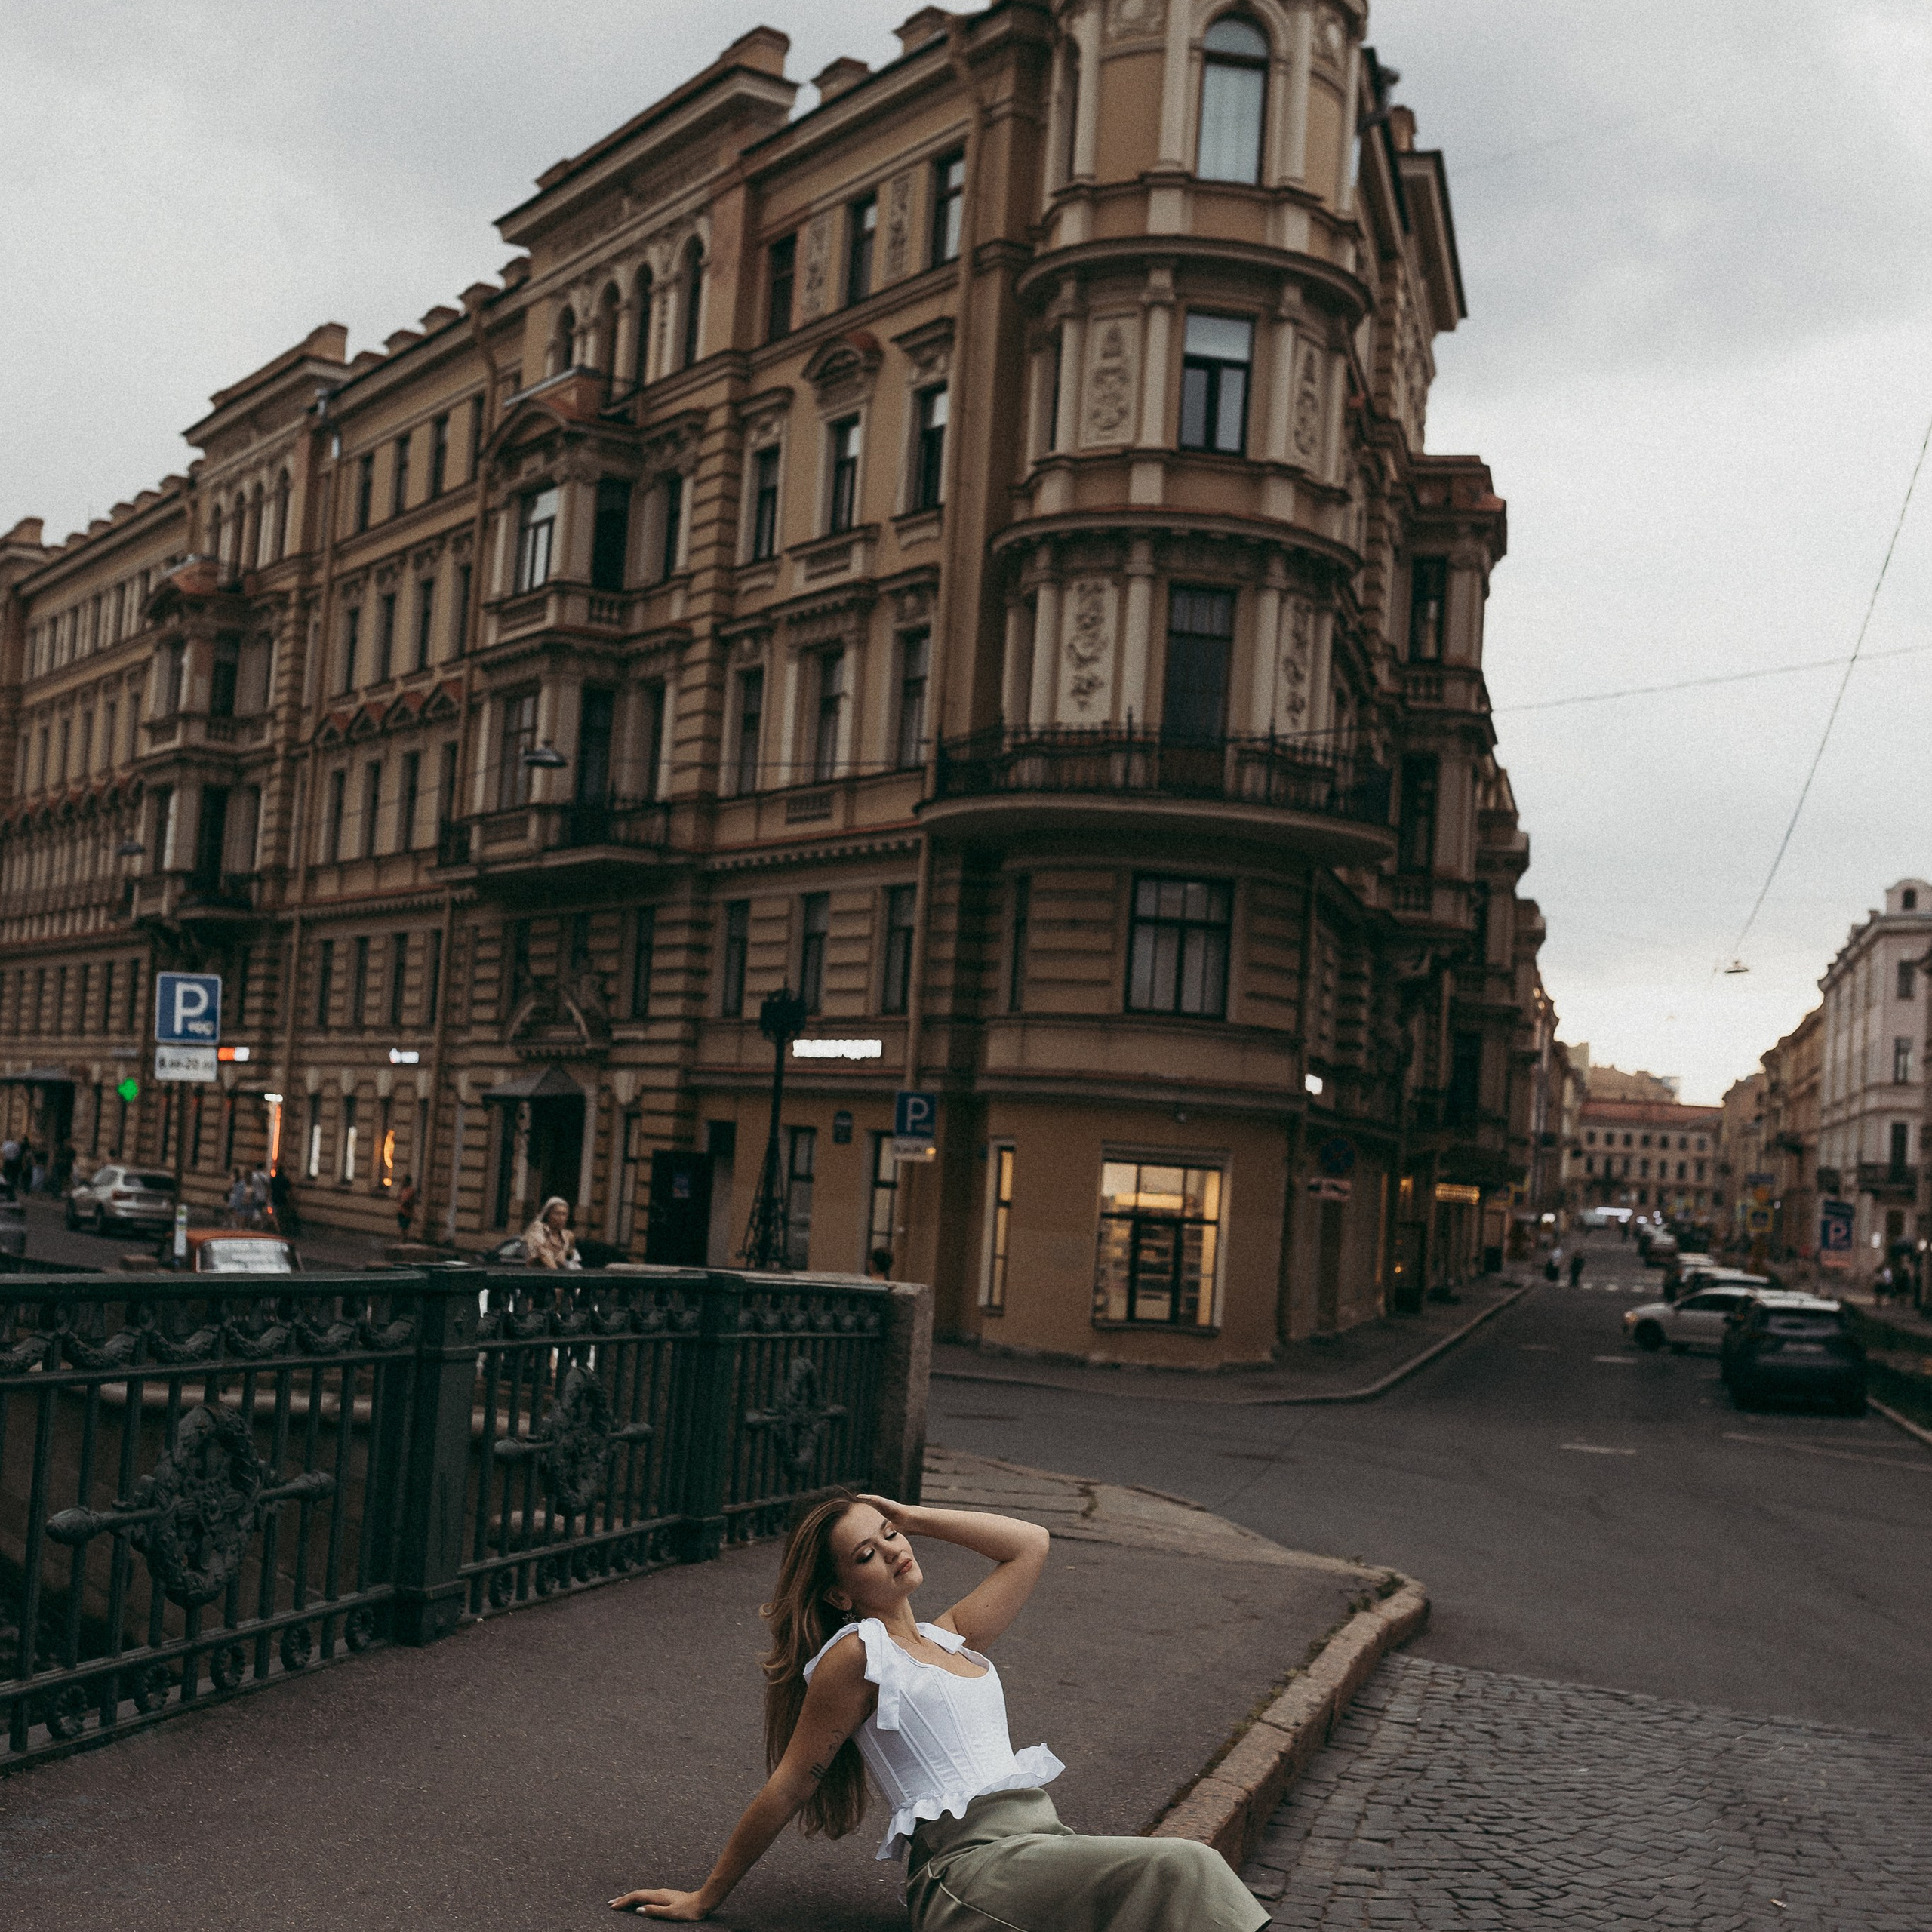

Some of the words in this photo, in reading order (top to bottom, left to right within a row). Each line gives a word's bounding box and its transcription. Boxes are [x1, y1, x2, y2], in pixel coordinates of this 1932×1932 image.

[174, 982, 208, 1035] P
[907, 1097, 928, 1131] P
[1829, 1223, 1847, 1245] P
